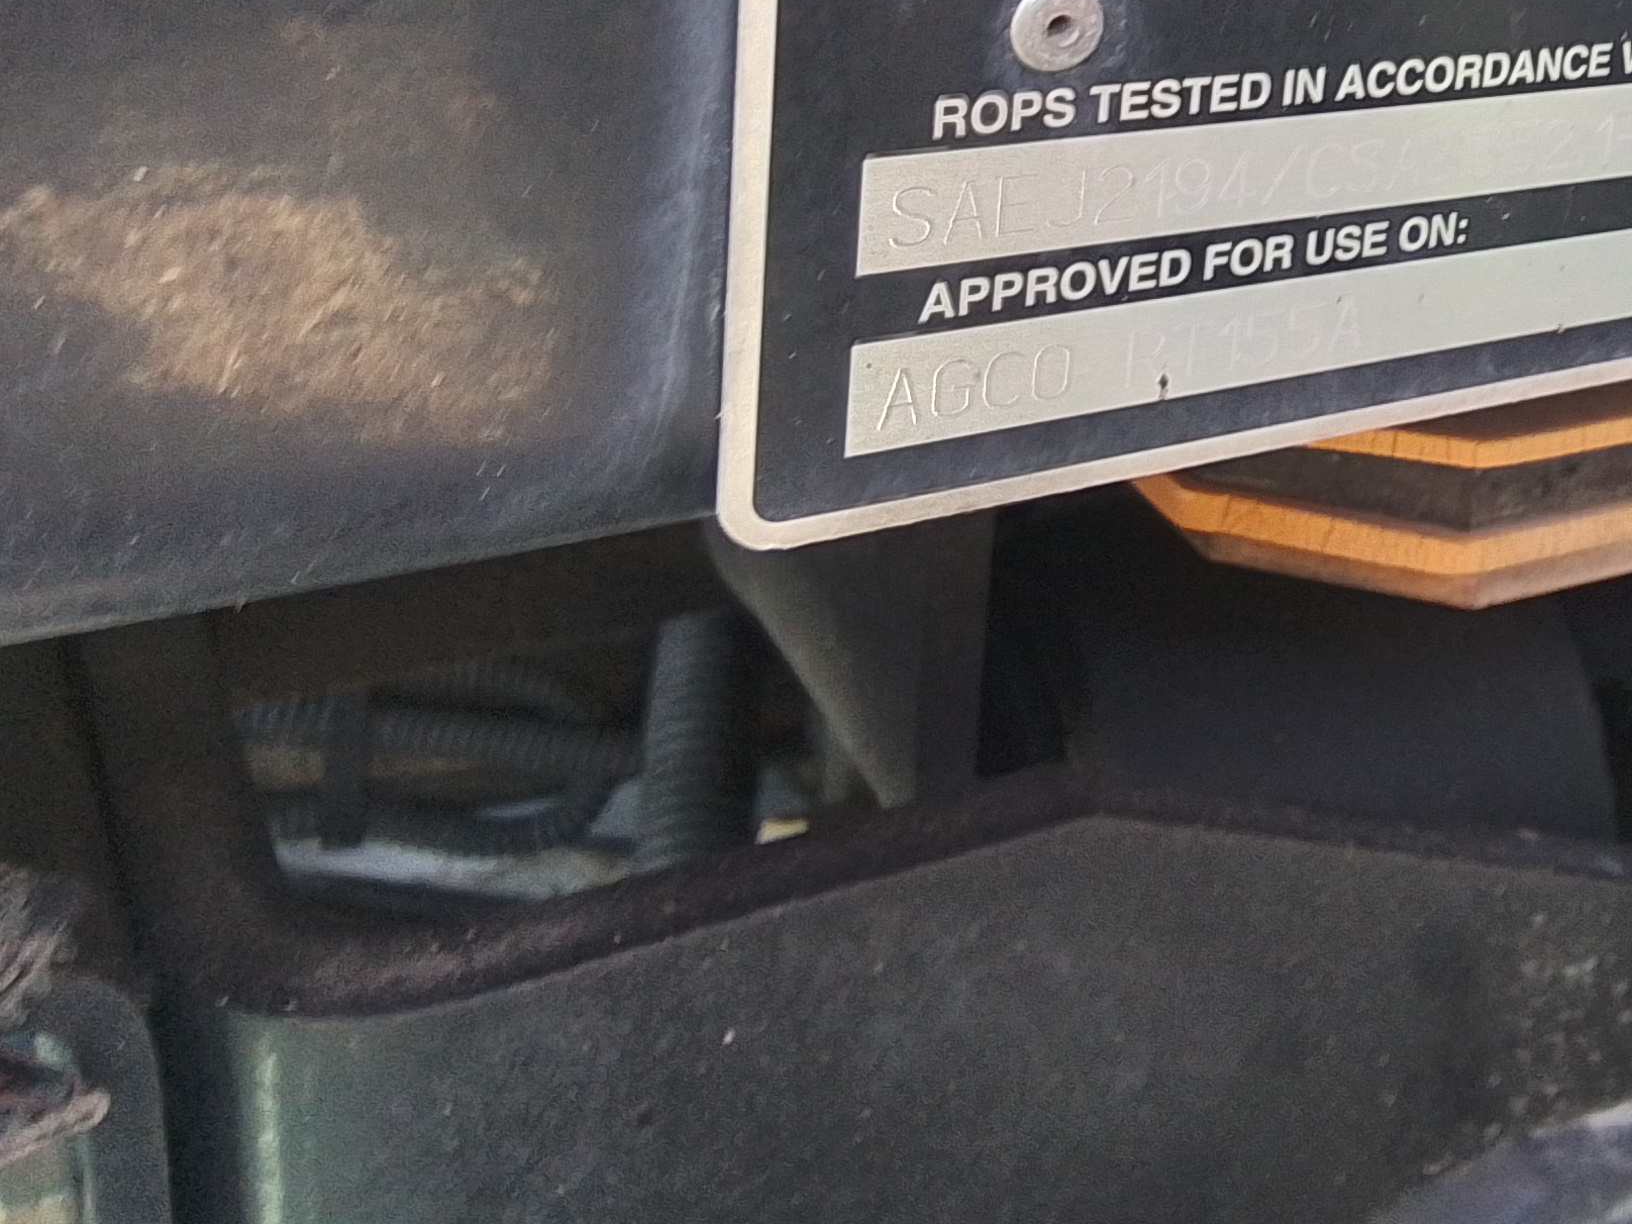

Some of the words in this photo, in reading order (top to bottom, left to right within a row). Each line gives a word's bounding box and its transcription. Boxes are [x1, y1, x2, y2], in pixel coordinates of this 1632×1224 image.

[932, 90, 1076, 140] ROPS
[1090, 72, 1271, 122] TESTED
[1282, 67, 1326, 107] IN
[1336, 42, 1612, 101] ACCORDANCE
[919, 249, 1190, 322] APPROVED
[1203, 234, 1292, 280] FOR
[1306, 222, 1390, 266] USE
[1399, 211, 1469, 254] ON:
[876, 343, 1072, 432] AGCO
